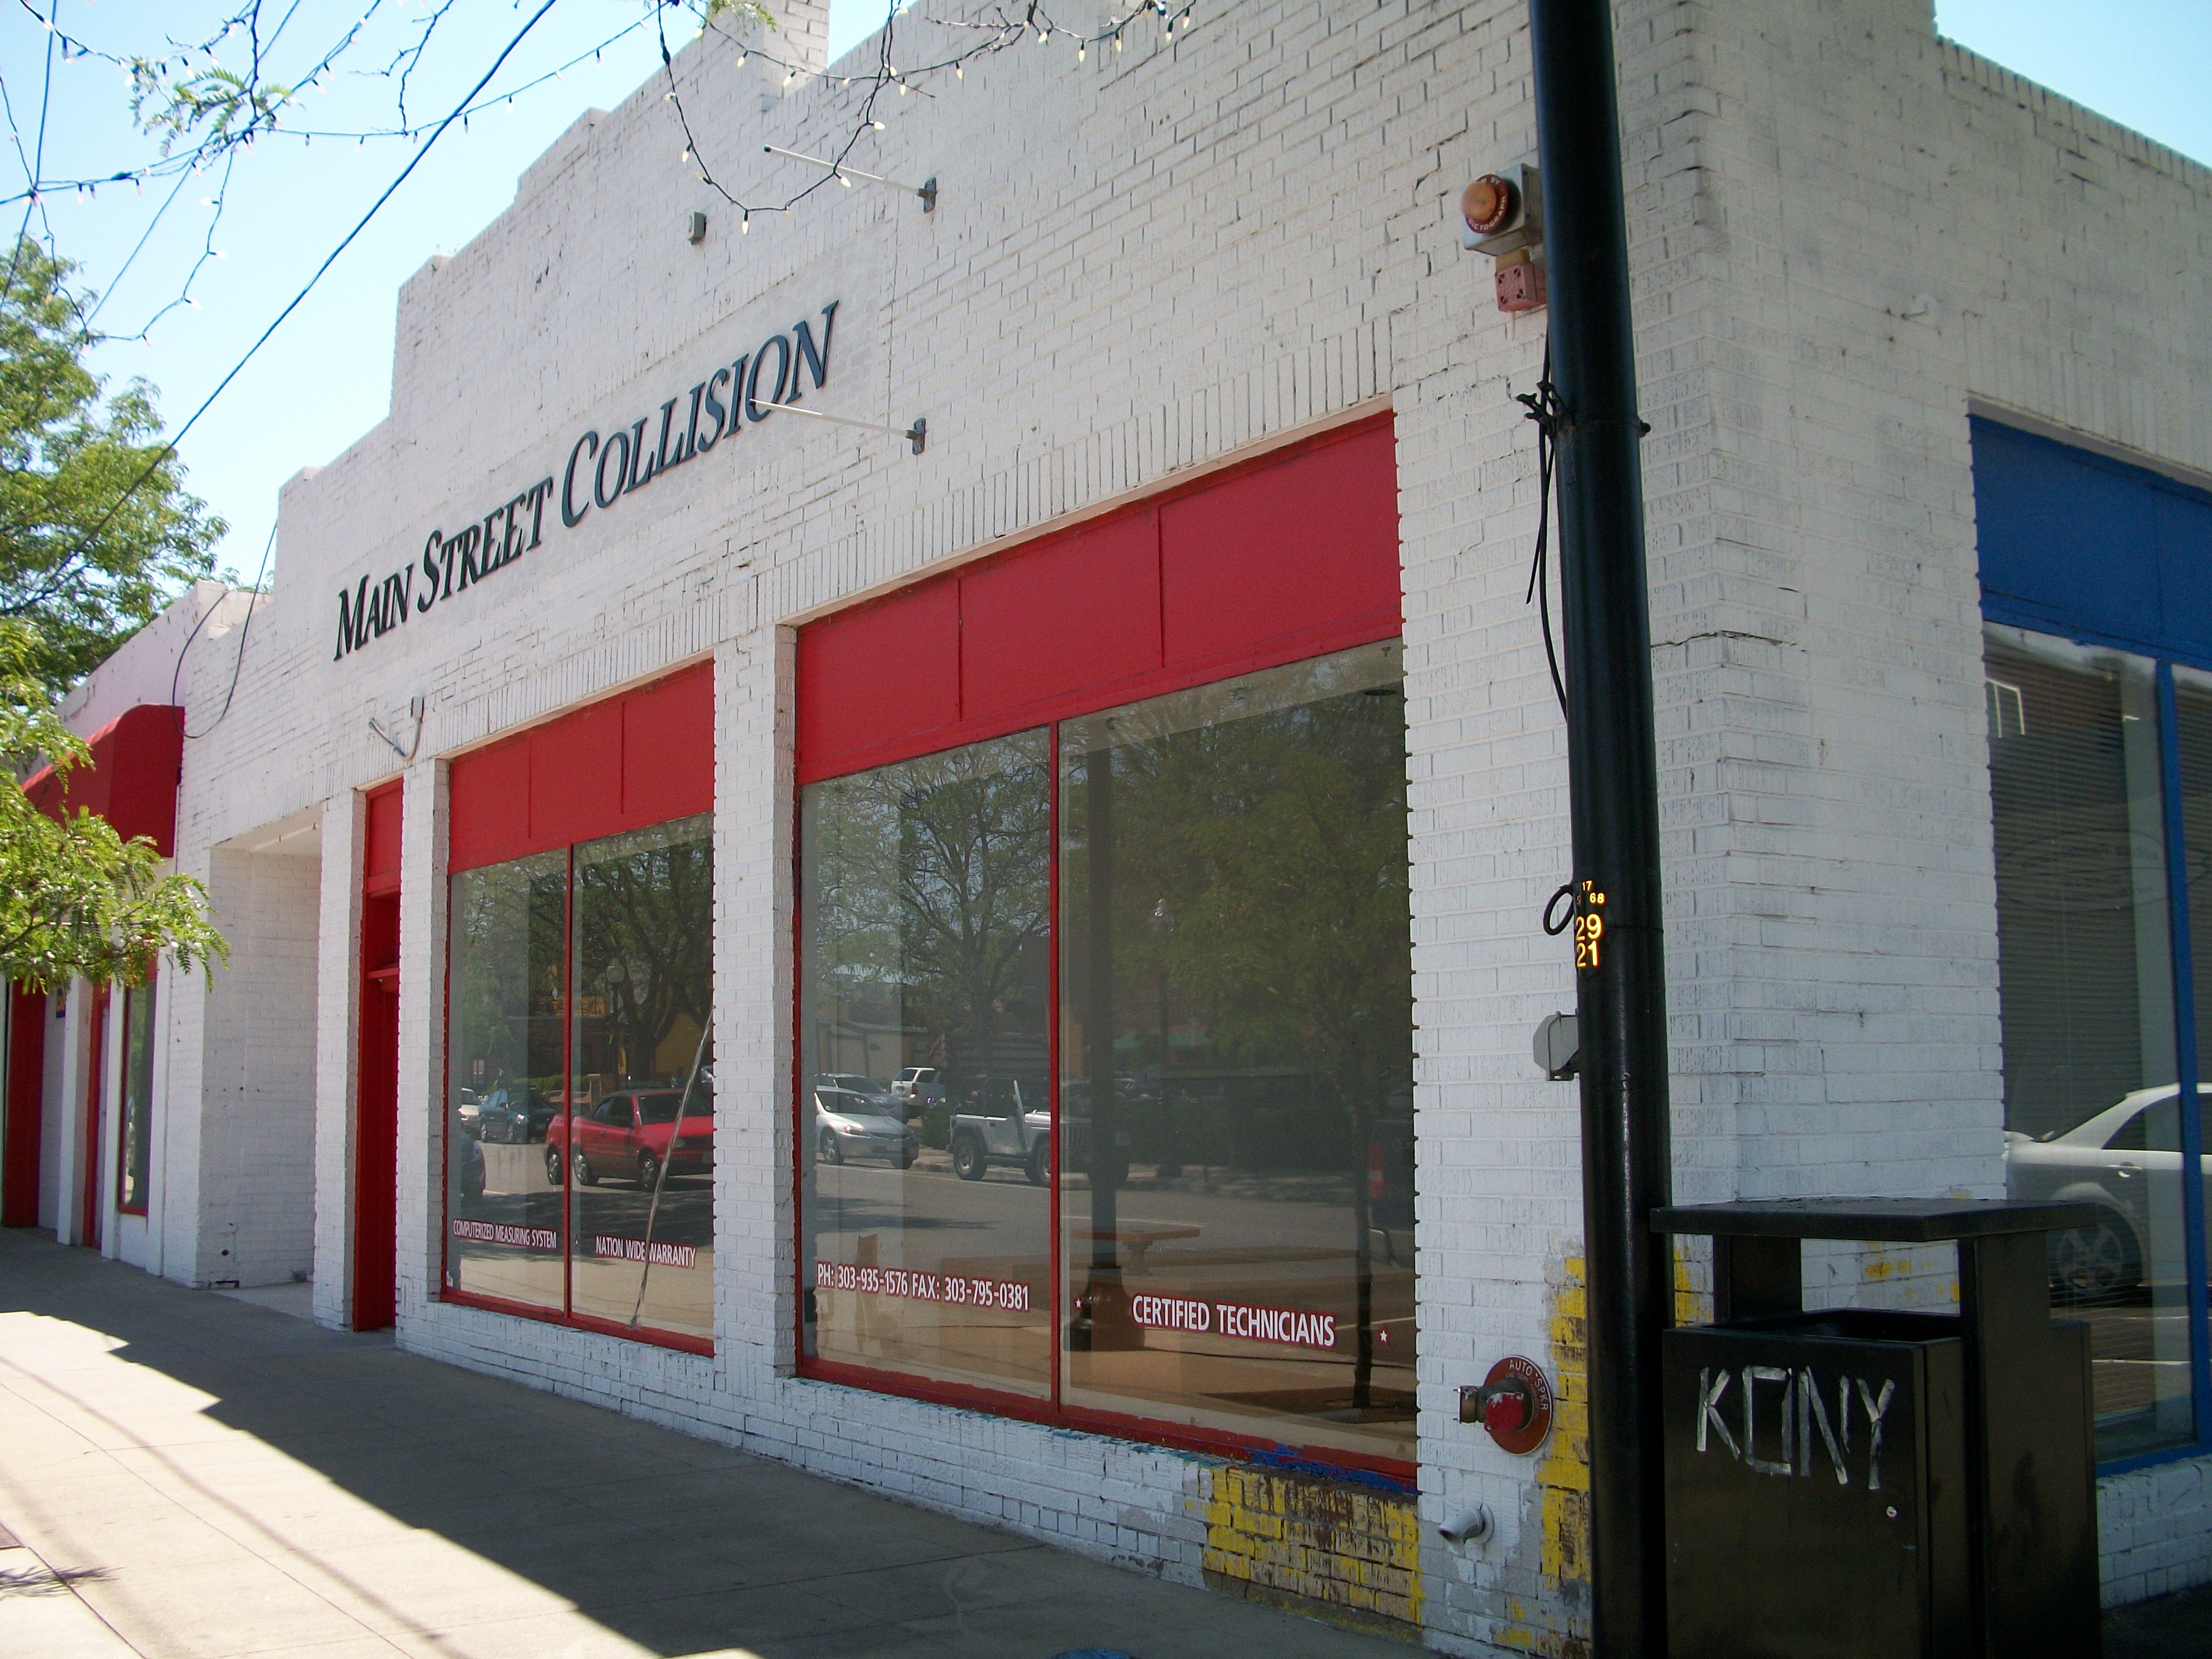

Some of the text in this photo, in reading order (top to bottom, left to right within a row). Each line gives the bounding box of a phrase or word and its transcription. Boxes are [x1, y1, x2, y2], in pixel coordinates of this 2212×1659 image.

[334, 300, 839, 661] MAIN STREET COLLISION
[1581, 880, 1593, 892] 17
[1589, 892, 1605, 904] 68
[1575, 913, 1602, 941] 29
[1576, 940, 1599, 968] 21
[453, 1219, 557, 1249] COMPUTERIZED MEASURING SYSTEM
[595, 1235, 697, 1267] NATION WIDE WARRANTY
[817, 1263, 1029, 1311] PH: 303-935-1576 FAX: 303-795-0381
[1133, 1295, 1335, 1346] CERTIFIED TECHNICIANS
[1696, 1364, 1896, 1490] KONY
